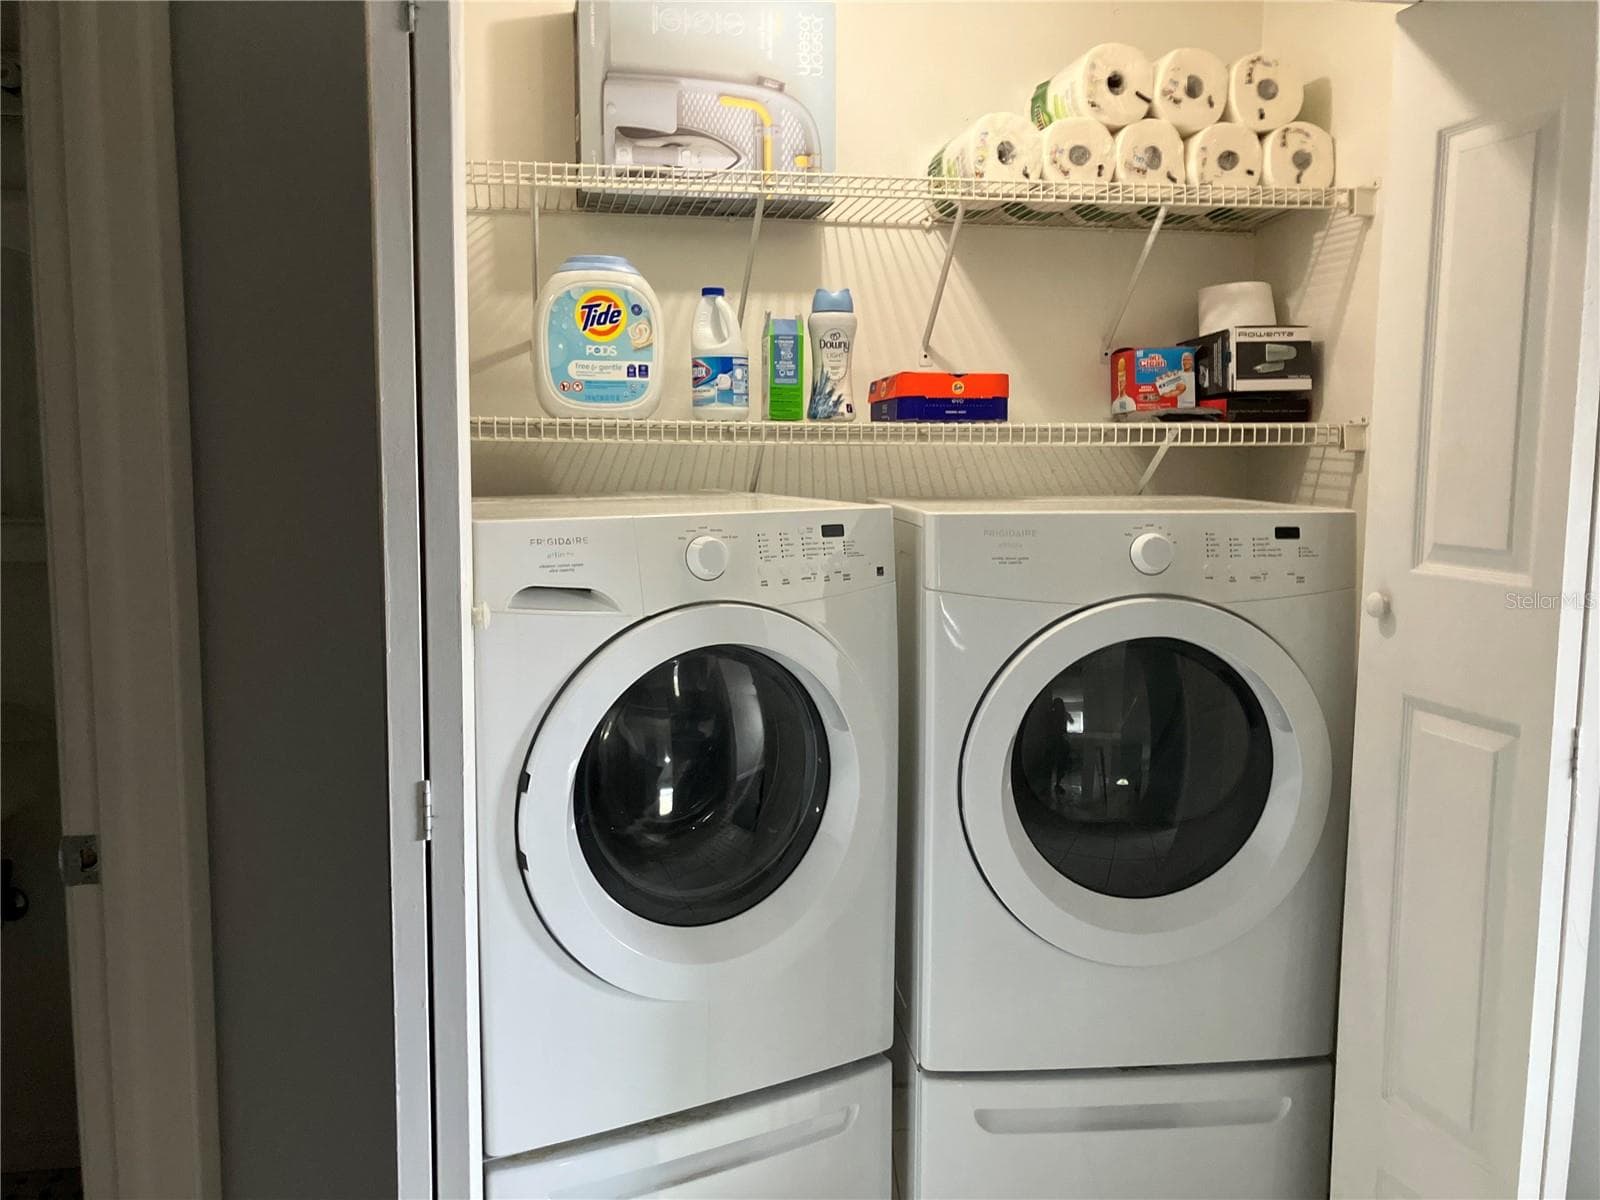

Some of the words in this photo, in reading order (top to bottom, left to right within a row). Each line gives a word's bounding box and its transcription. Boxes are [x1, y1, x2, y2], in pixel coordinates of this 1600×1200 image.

[580, 302, 622, 332] Tide
[585, 345, 617, 357] PODS
[819, 338, 850, 353] Downy
[575, 362, 591, 370] free
[599, 363, 623, 373] gentle
[529, 536, 590, 546] FRIGIDAIRE
